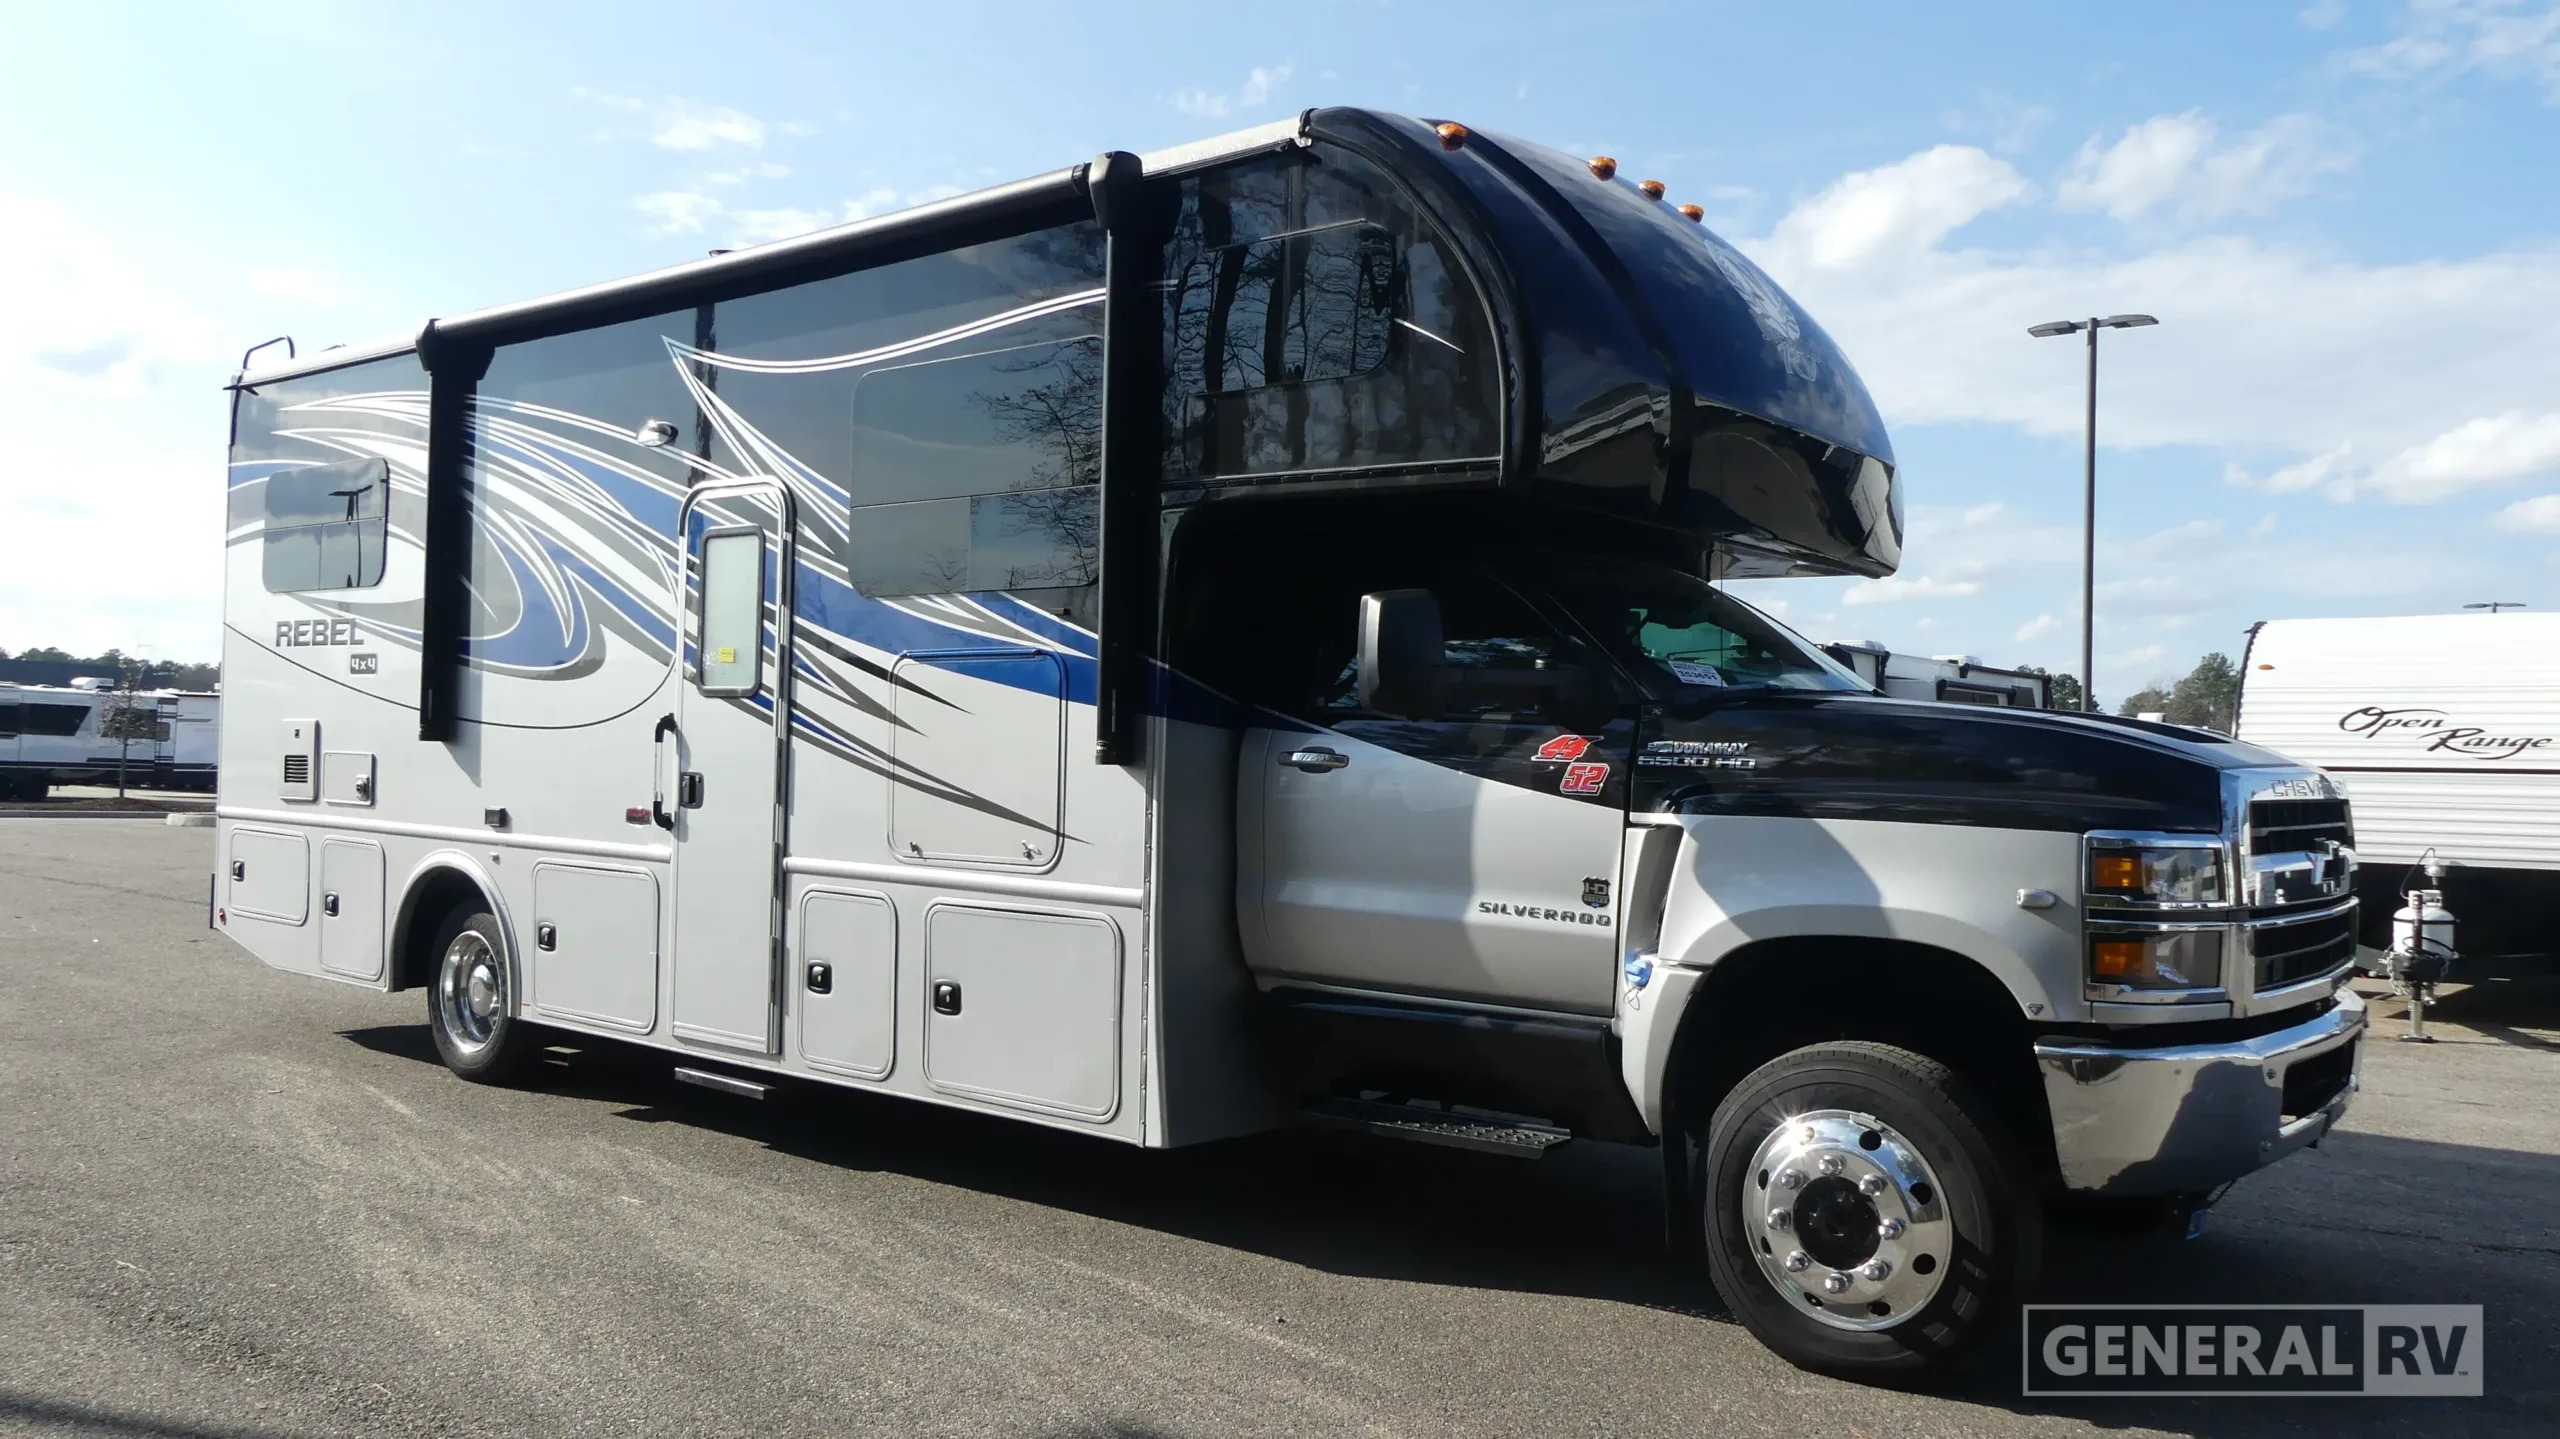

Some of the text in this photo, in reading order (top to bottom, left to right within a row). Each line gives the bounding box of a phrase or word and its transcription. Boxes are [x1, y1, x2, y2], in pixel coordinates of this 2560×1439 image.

[276, 618, 365, 647] REBEL
[351, 658, 376, 670] 4x4
[2338, 706, 2449, 739] Open
[1673, 741, 1749, 756] DURAMAX
[2416, 727, 2553, 760] Range
[1715, 757, 1757, 770] HD
[1561, 763, 1609, 795] 52
[1478, 901, 1612, 927] SILVERADO
